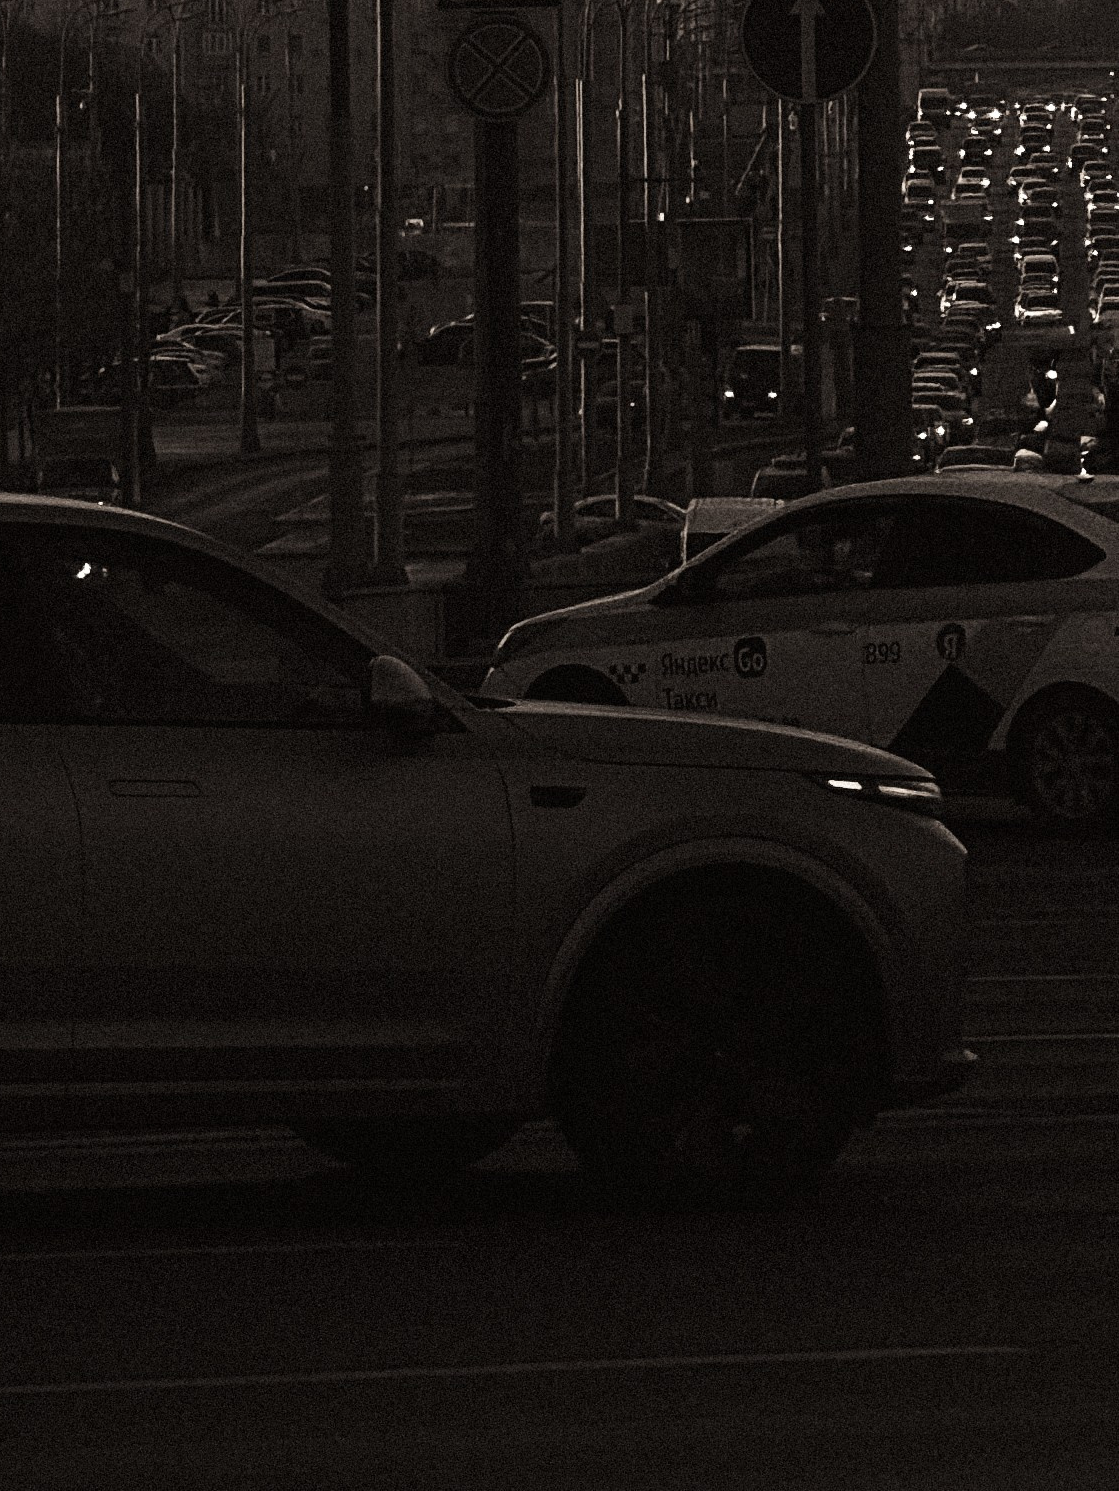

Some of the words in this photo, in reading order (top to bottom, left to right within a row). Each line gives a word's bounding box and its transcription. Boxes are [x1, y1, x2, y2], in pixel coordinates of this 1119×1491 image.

[661, 653, 730, 677] Яндекс
[737, 646, 765, 673] Go
[662, 687, 718, 711] Такси
